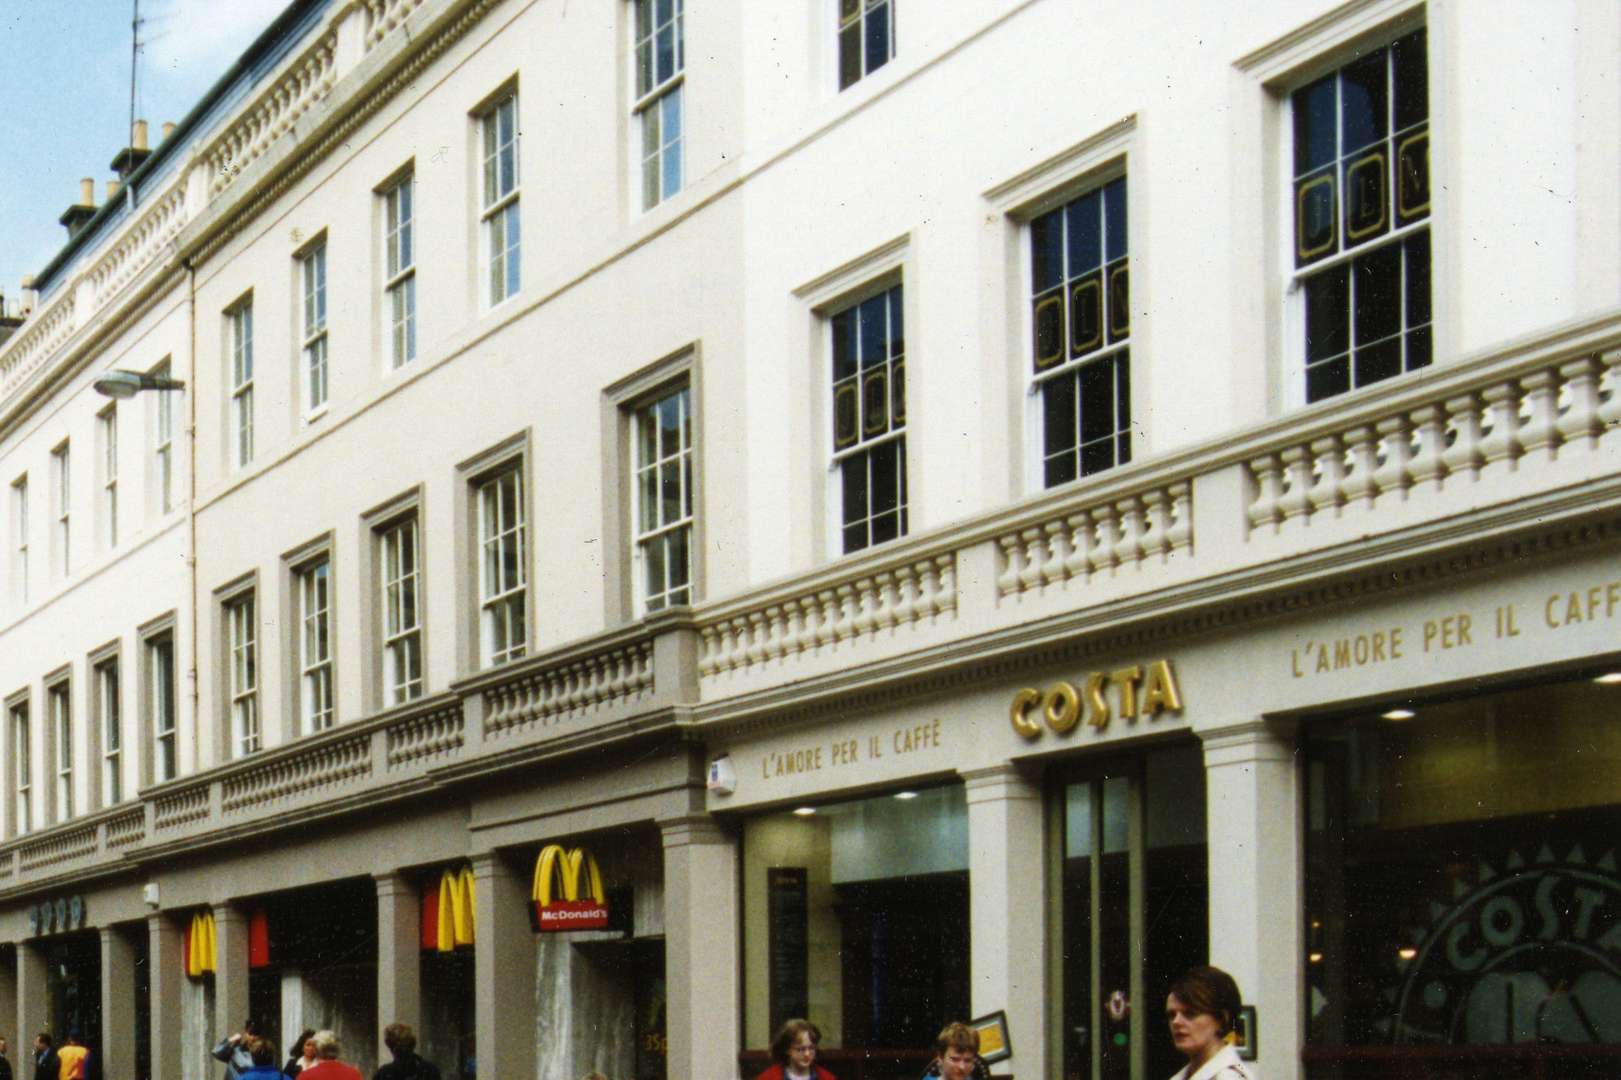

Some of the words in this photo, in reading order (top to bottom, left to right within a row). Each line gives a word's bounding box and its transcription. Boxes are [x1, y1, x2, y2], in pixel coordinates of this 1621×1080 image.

[1290, 627, 1403, 678] L'AMORE
[1423, 613, 1473, 652] PER
[1495, 603, 1521, 639] IL
[1009, 659, 1184, 738] COSTA
[763, 747, 822, 780] L'AMORE
[832, 739, 858, 766] PER
[869, 734, 882, 759] IL
[541, 909, 608, 921] McDonald's
